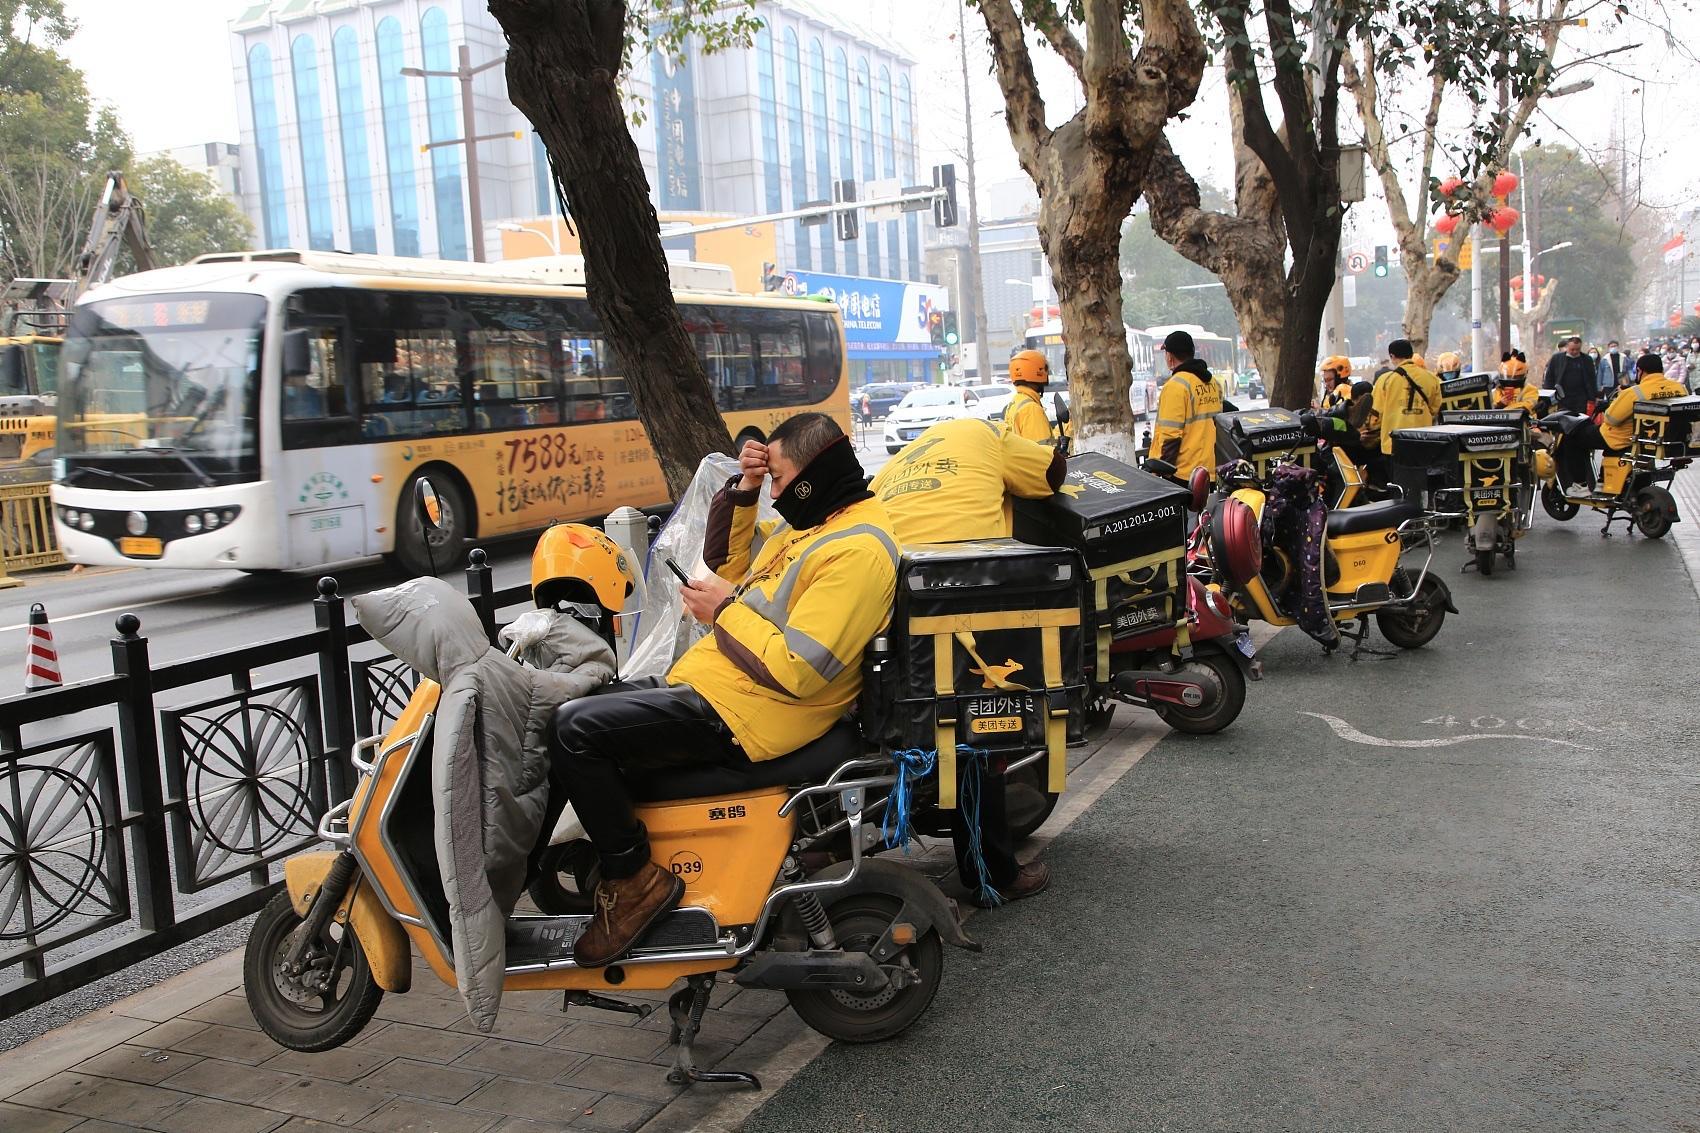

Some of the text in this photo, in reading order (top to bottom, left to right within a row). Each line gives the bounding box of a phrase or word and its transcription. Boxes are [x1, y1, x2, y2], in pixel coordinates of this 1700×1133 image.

[840, 289, 881, 319] 中国电信
[859, 320, 882, 329] TELECOM
[1104, 505, 1176, 535] A2012012-001
[1116, 607, 1160, 629] 美团外卖
[977, 719, 1017, 731] 美团专送
[672, 861, 702, 875] D39
